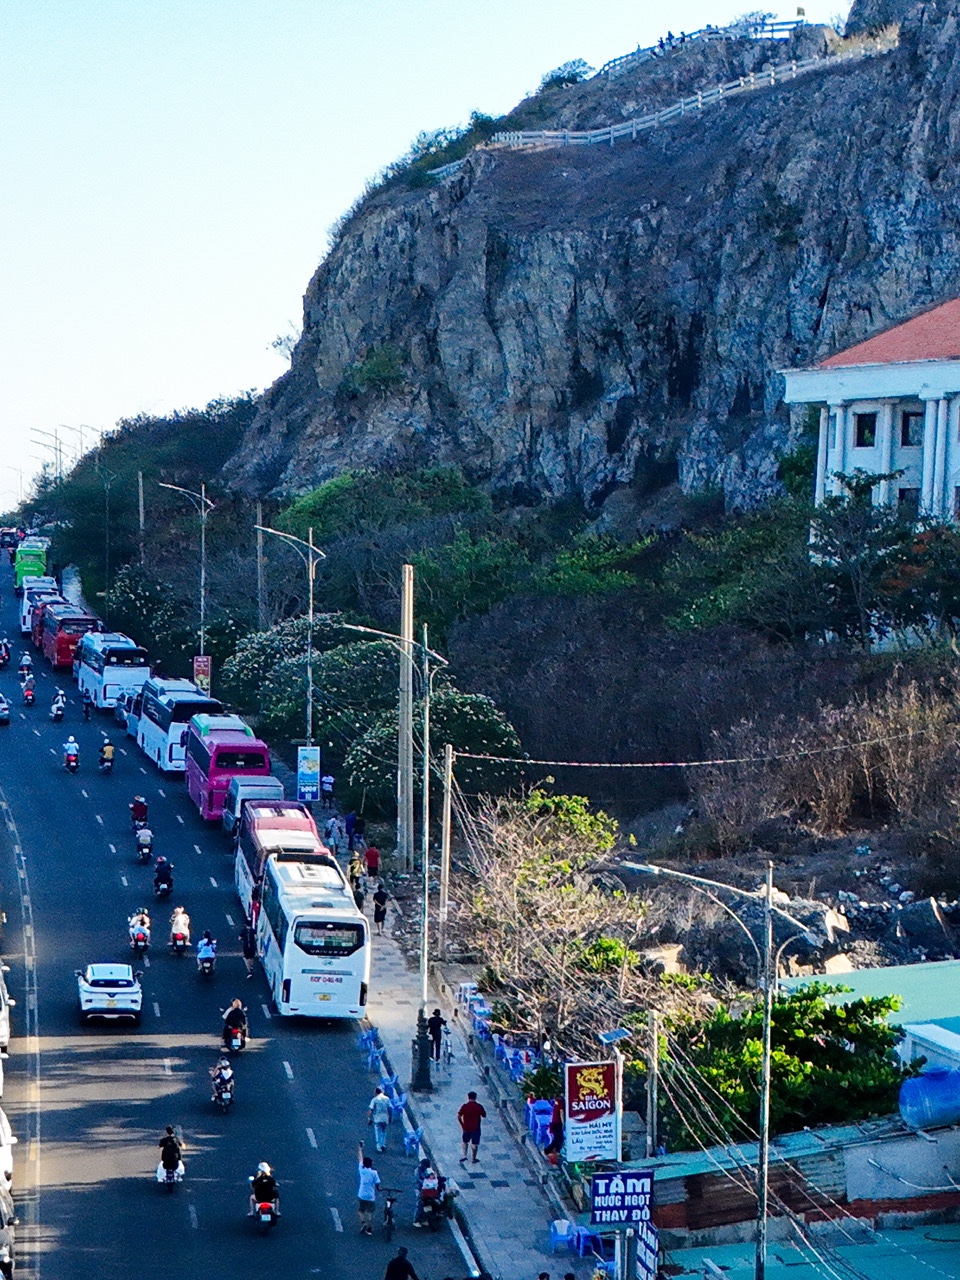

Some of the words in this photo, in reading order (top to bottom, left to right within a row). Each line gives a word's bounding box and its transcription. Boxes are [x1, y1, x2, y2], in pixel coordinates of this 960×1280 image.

[571, 1099, 611, 1111] SAIGON
[594, 1194, 622, 1207] NƯỚC
[625, 1194, 651, 1208] NGỌT
[594, 1209, 628, 1222] THAY
